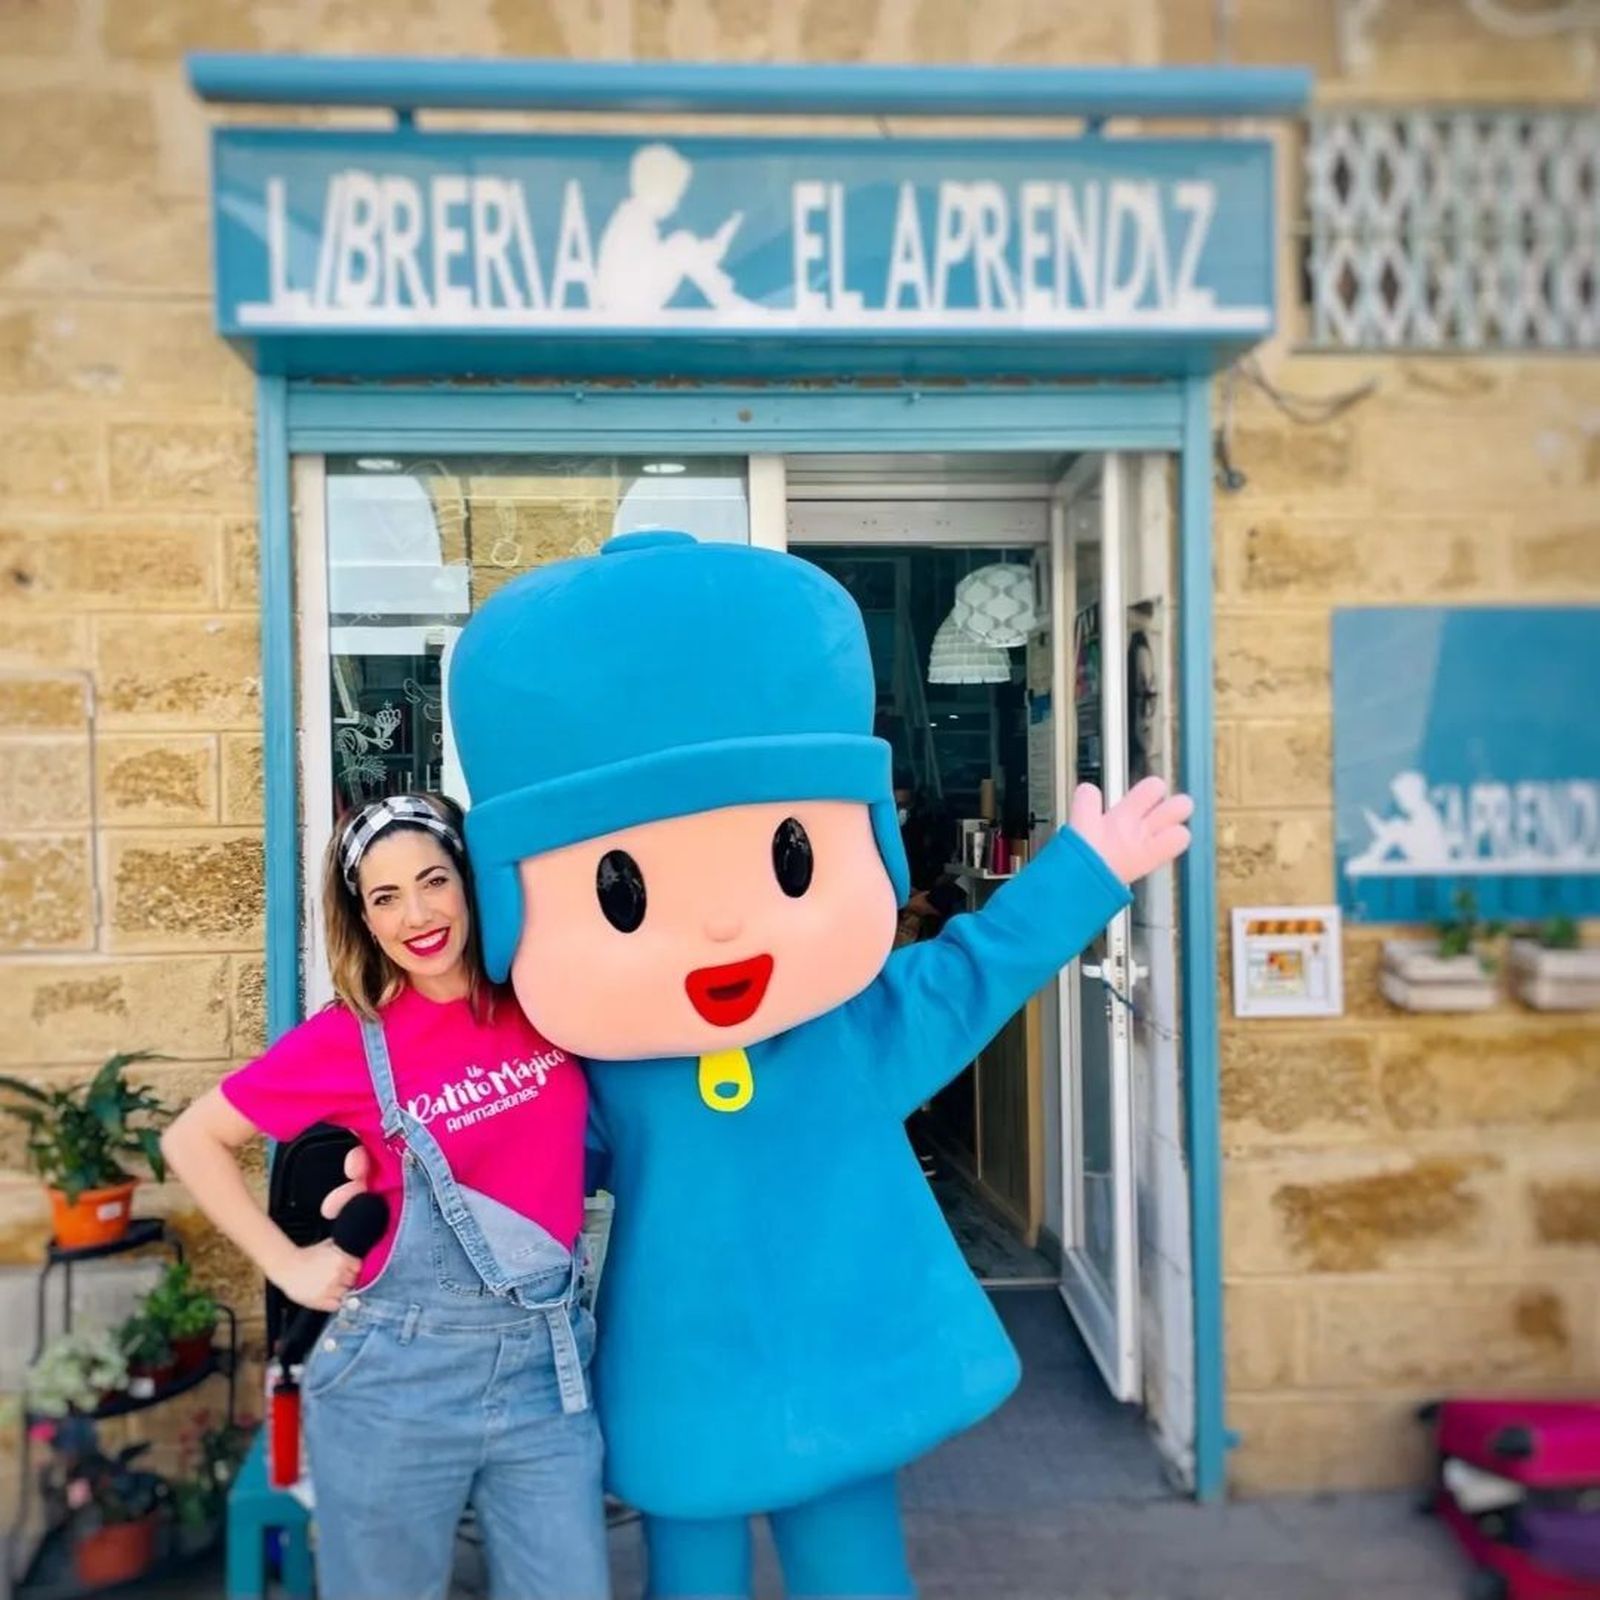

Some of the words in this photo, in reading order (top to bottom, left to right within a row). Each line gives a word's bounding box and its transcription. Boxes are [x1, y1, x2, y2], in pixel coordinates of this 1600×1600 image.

[267, 171, 597, 308] LIBRERIA
[793, 181, 862, 308] EL
[886, 181, 1216, 308] APRENDIZ
[407, 1080, 493, 1125] Ratito
[488, 1049, 566, 1096] Mágico
[446, 1085, 539, 1133] Animaciones
